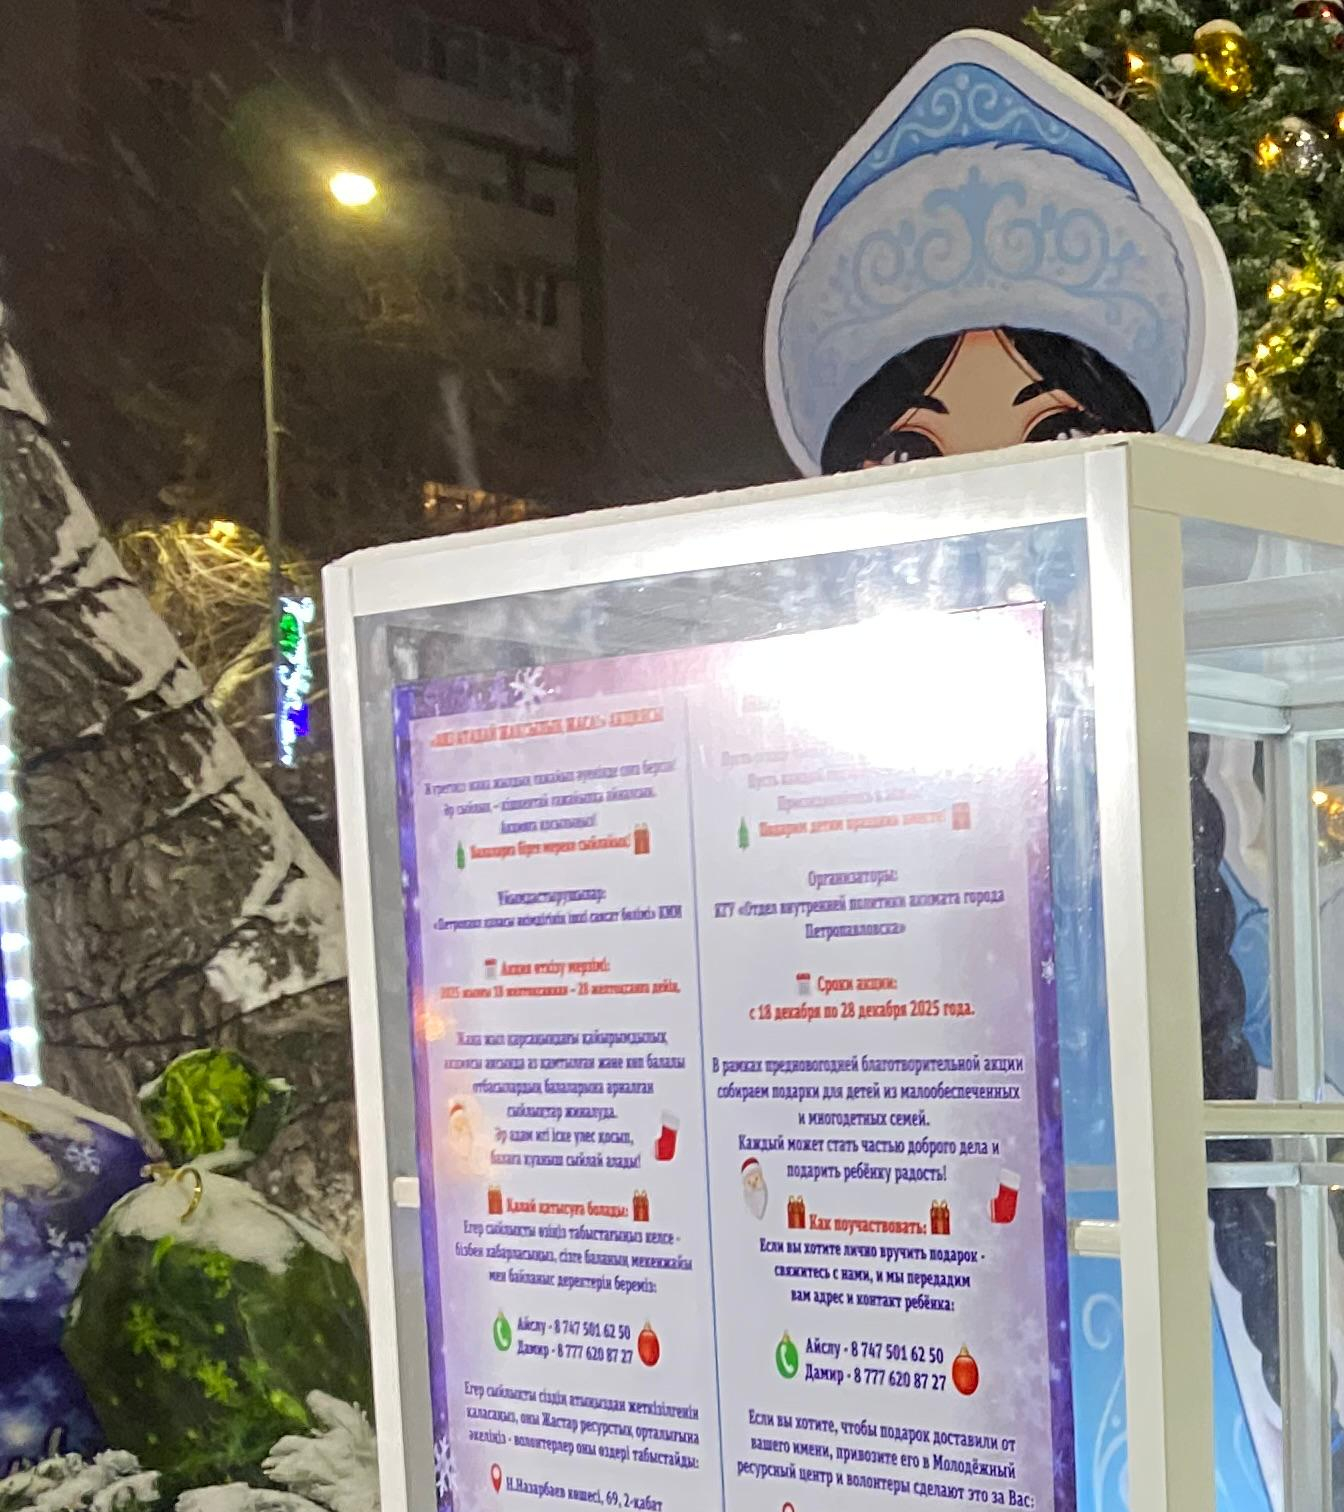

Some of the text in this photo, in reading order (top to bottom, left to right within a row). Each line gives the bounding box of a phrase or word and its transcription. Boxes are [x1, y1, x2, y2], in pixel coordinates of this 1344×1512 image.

[816, 974, 897, 994] Сроки акции:
[758, 1003, 772, 1019] 18
[774, 1002, 820, 1022] декабря
[823, 1005, 838, 1018] по
[840, 1001, 855, 1017] 28
[857, 1000, 907, 1020] декабря
[909, 999, 940, 1016] 2025
[942, 1002, 975, 1018] года.
[722, 1059, 761, 1075] рамках
[764, 1055, 859, 1075] предновогодней
[860, 1054, 980, 1075] благотворительной
[983, 1058, 1023, 1074] акции
[716, 1081, 1020, 1101] собираем подарки для детей из малообеспеченных
[808, 1111, 887, 1127] многодетных
[889, 1109, 930, 1126] семей.
[737, 1133, 784, 1152] Каждый
[787, 1137, 824, 1150] может
[826, 1138, 859, 1151] стать
[861, 1139, 904, 1152] частью
[907, 1136, 956, 1157] доброго
[959, 1141, 989, 1156] дела
[786, 1163, 841, 1180] подарить
[894, 1164, 947, 1183] радость!
[808, 1213, 927, 1235] Как поучаствовать:
[759, 1235, 978, 1266] Если вы хотите лично вручить подарок
[774, 1263, 830, 1279] свяжитесь
[841, 1267, 873, 1284] нами,
[885, 1270, 904, 1284] мы
[906, 1271, 970, 1289] передадим
[790, 1288, 810, 1301] вам
[812, 1289, 844, 1307] адрес
[856, 1292, 901, 1308] контакт
[805, 1336, 840, 1358] Айслу
[860, 1341, 882, 1358] 747
[885, 1343, 907, 1360] 501
[910, 1345, 925, 1362] 62
[928, 1346, 944, 1364] 50
[804, 1362, 844, 1385] Дамир
[863, 1367, 885, 1385] 777
[888, 1369, 911, 1387] 620
[913, 1372, 928, 1389] 87
[931, 1373, 946, 1391] 27
[748, 1408, 1016, 1452] Если вы хотите, чтобы подарок доставили от
[750, 1436, 790, 1453] вашего
[792, 1441, 833, 1460] имени,
[835, 1446, 897, 1465] привозите
[899, 1453, 920, 1468] его
[932, 1453, 1015, 1479] Молодёжный
[736, 1460, 796, 1479] ресурсный
[798, 1467, 833, 1487] центр
[846, 1473, 910, 1495] волонтеры
[912, 1481, 965, 1500] сделают
[967, 1487, 989, 1503] это
[991, 1490, 1005, 1505] за
[1008, 1489, 1035, 1508] Вас:
